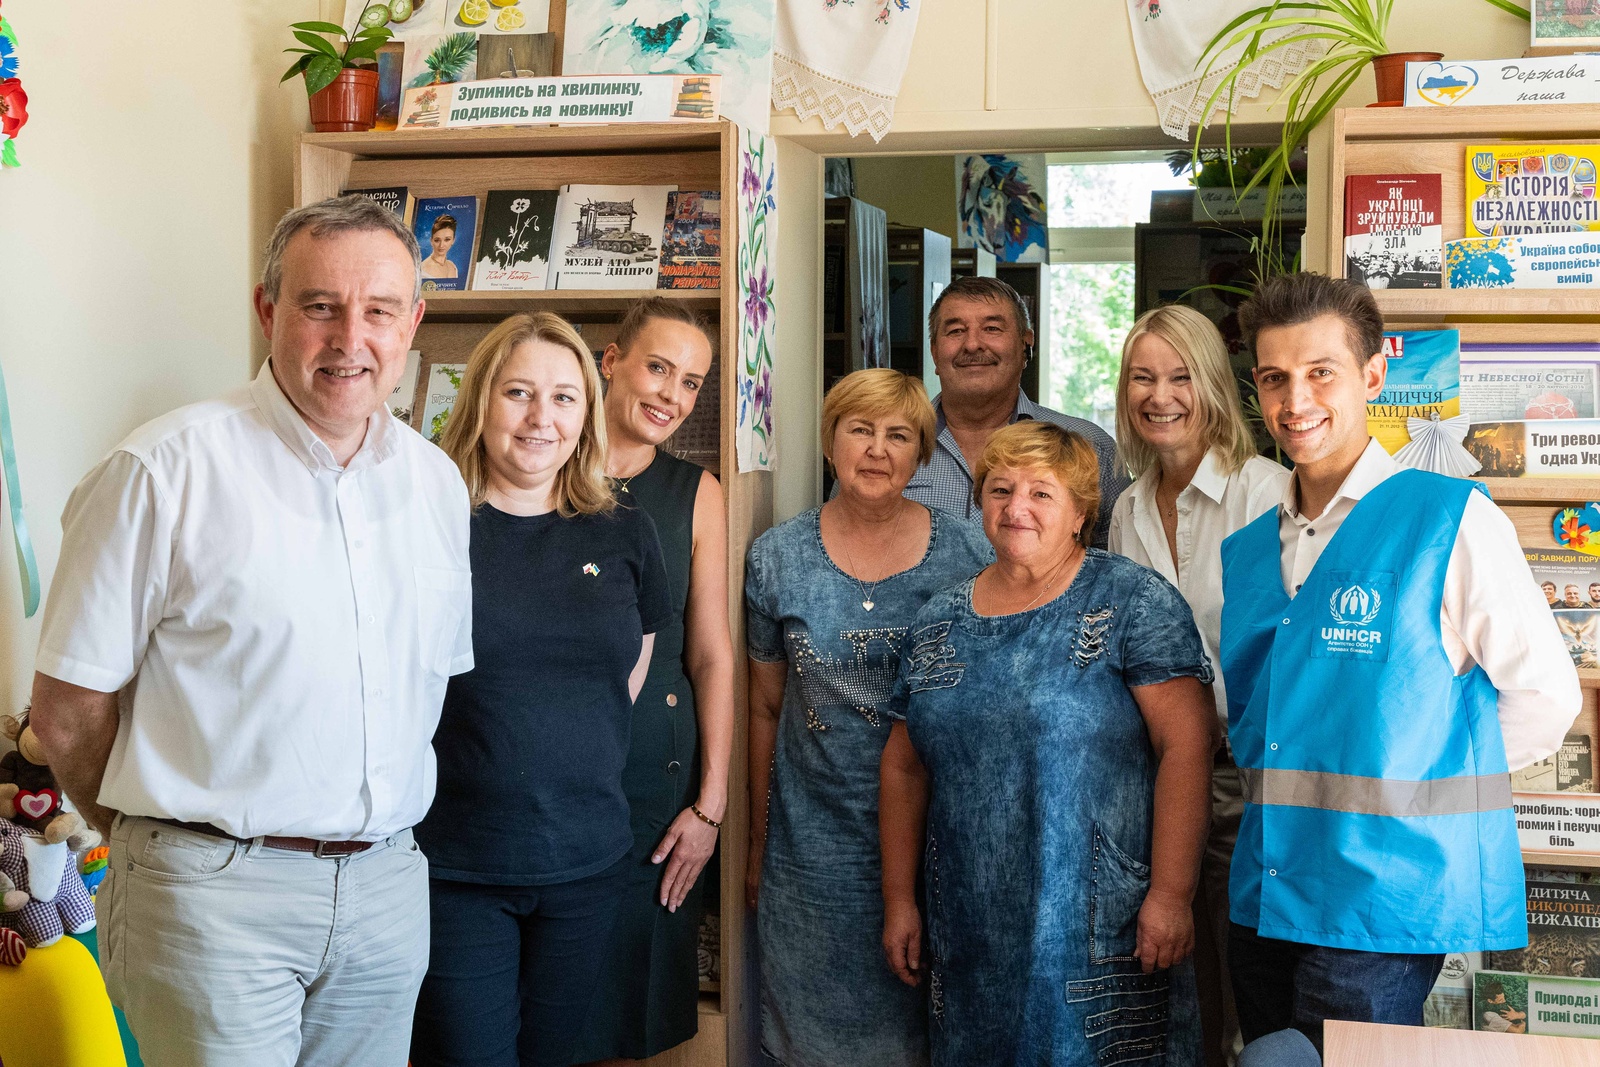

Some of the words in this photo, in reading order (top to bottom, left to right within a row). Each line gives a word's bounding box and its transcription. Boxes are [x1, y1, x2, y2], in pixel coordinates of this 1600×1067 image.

[1501, 63, 1587, 83] Держава
[458, 86, 533, 101] Зупинись
[537, 84, 556, 97] на
[561, 82, 643, 97] хвилинку,
[1517, 92, 1566, 101] наша
[450, 105, 529, 121] подивись
[532, 105, 552, 118] на
[559, 101, 633, 117] новинку!
[1505, 176, 1568, 196] ІСТОРІЯ
[1389, 187, 1403, 200] ЯК
[1368, 198, 1423, 213] УКРАЇНЦІ
[1476, 201, 1598, 221] НЕЗАЛЕЖНОСТІ
[1357, 212, 1434, 225] ЗРУЙНУВАЛИ
[1369, 224, 1422, 236] ІМПЕРІЮ
[1384, 237, 1406, 249] ЗЛА
[1520, 244, 1566, 257] Україна
[565, 257, 603, 267] МУЗЕЙ
[607, 258, 631, 267] АТО
[605, 267, 654, 277] ДНІПРО
[1557, 273, 1593, 284] вимір
[672, 278, 720, 288] РЕПОРТАЖ
[1478, 373, 1542, 382] НЕБЕСНОЇ
[1545, 373, 1584, 382] СОТНІ
[1531, 433, 1558, 448] Три
[1541, 453, 1577, 467] одна
[1581, 452, 1600, 466] Ук
[1526, 553, 1538, 561] ВОЇ
[1540, 554, 1576, 563] ЗАВЖДИ
[1321, 628, 1382, 644] UNHCR
[1559, 746, 1591, 754] ЕРНОБЫЛЬ-
[1514, 804, 1573, 816] орнобиль:
[1516, 820, 1555, 830] помин
[1558, 820, 1561, 831] і
[1549, 835, 1575, 847] біль
[1529, 887, 1590, 900] ДИТЯЧА
[1535, 991, 1592, 1008] Природа
[1594, 995, 1598, 1007] і
[1538, 1010, 1570, 1023] грані
